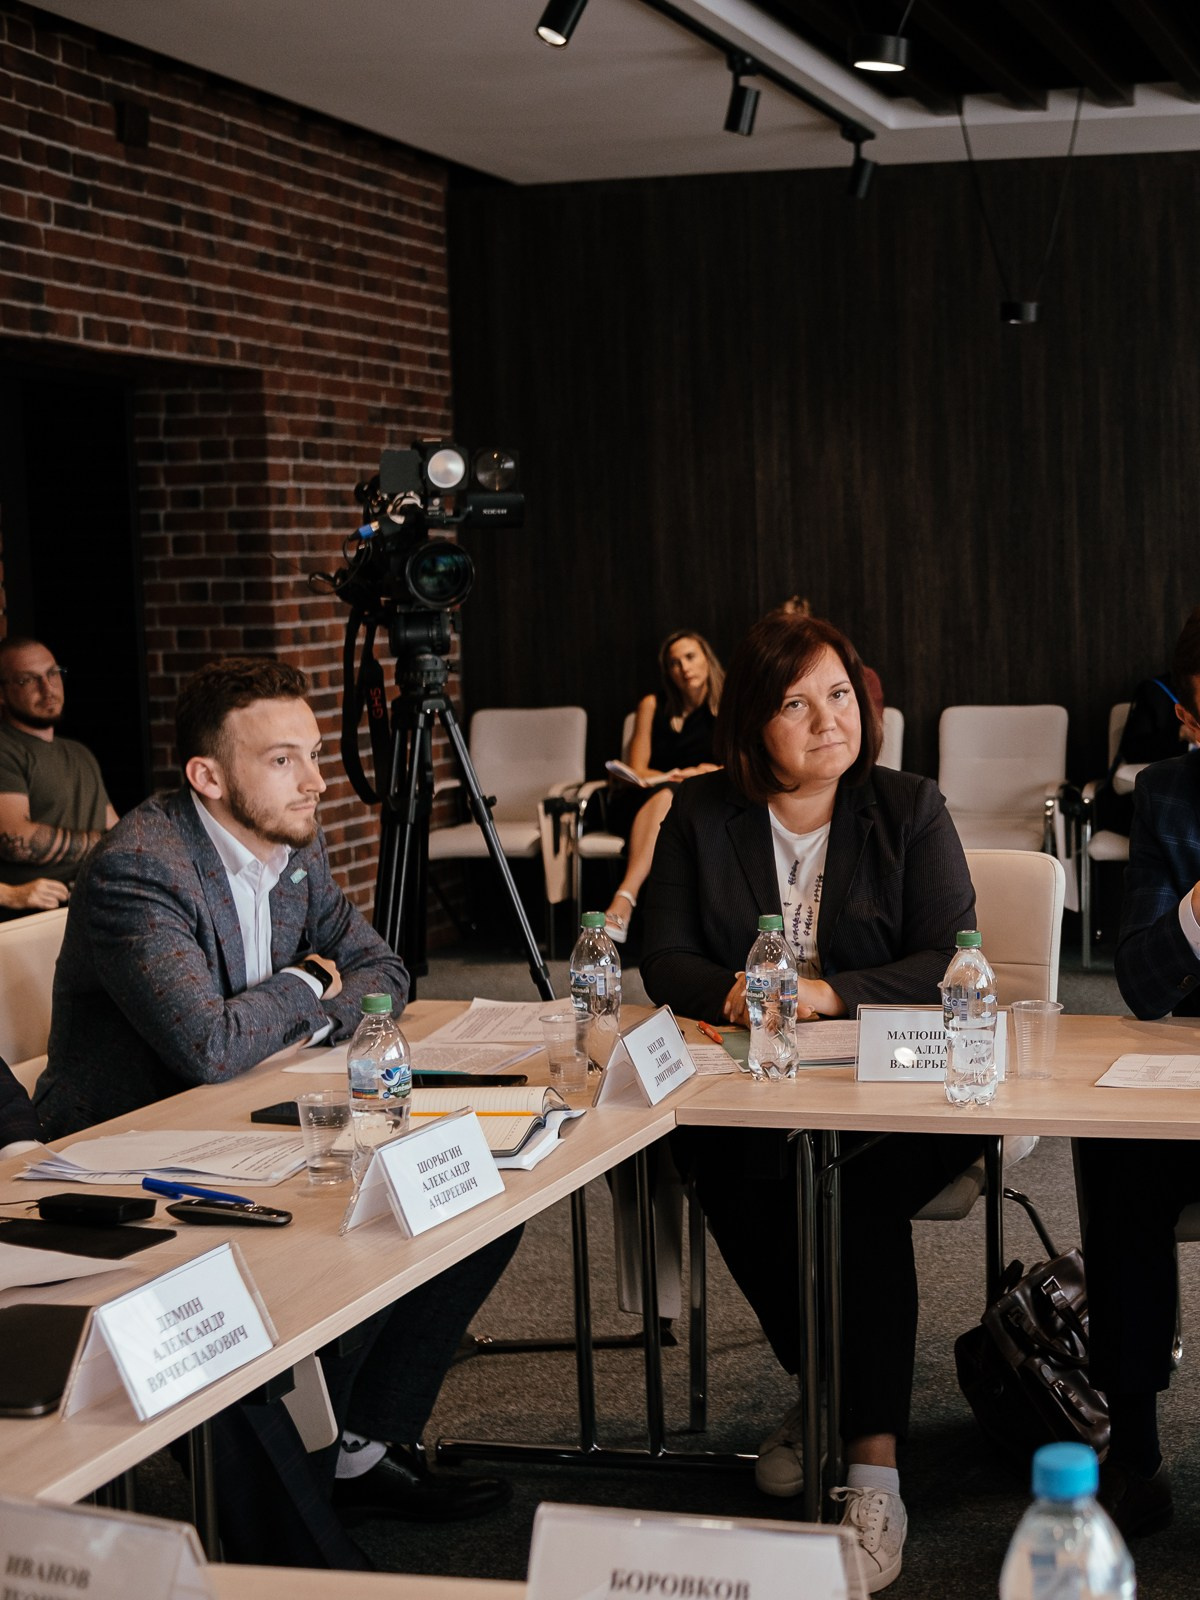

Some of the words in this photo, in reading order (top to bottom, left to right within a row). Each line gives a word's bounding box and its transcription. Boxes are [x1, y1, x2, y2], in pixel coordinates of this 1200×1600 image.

[647, 1036, 666, 1055] КОТЛЕР
[655, 1050, 672, 1069] ДАНИЛ
[914, 1045, 948, 1055] АЛЛА
[654, 1058, 684, 1087] ДМИТРИЕВИЧ
[417, 1145, 463, 1174] ШОРЫГИН
[422, 1160, 471, 1192] АЛЕКСАНДР
[429, 1177, 478, 1209] АНДРЕЕВИЧ
[156, 1296, 204, 1333] ДЕМИН
[152, 1310, 225, 1362] АЛЕКСАНДР
[146, 1325, 249, 1393] ВЯЧЕСЛАВОВИЧ
[5, 1554, 91, 1590] ИВАНОВ
[610, 1567, 751, 1600] БОРОВКОВ
